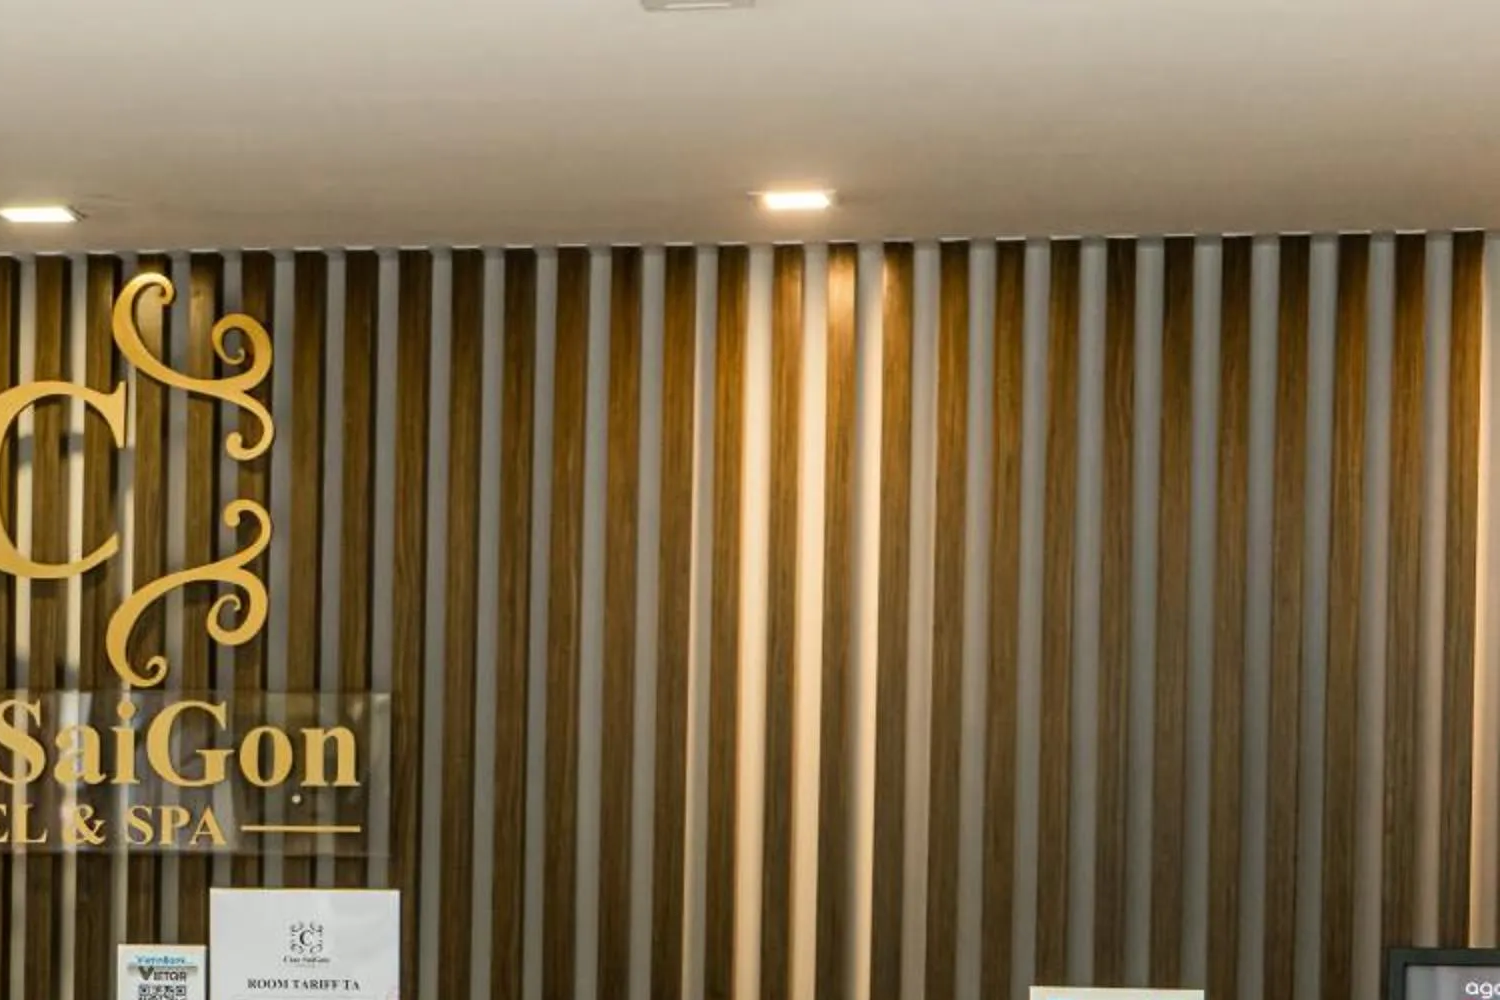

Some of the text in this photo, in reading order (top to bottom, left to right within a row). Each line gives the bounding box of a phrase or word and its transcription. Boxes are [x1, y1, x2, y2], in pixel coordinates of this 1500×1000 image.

[61, 804, 106, 845] &
[125, 805, 227, 846] SPA
[247, 978, 361, 991] ROOM TARIFF TA
